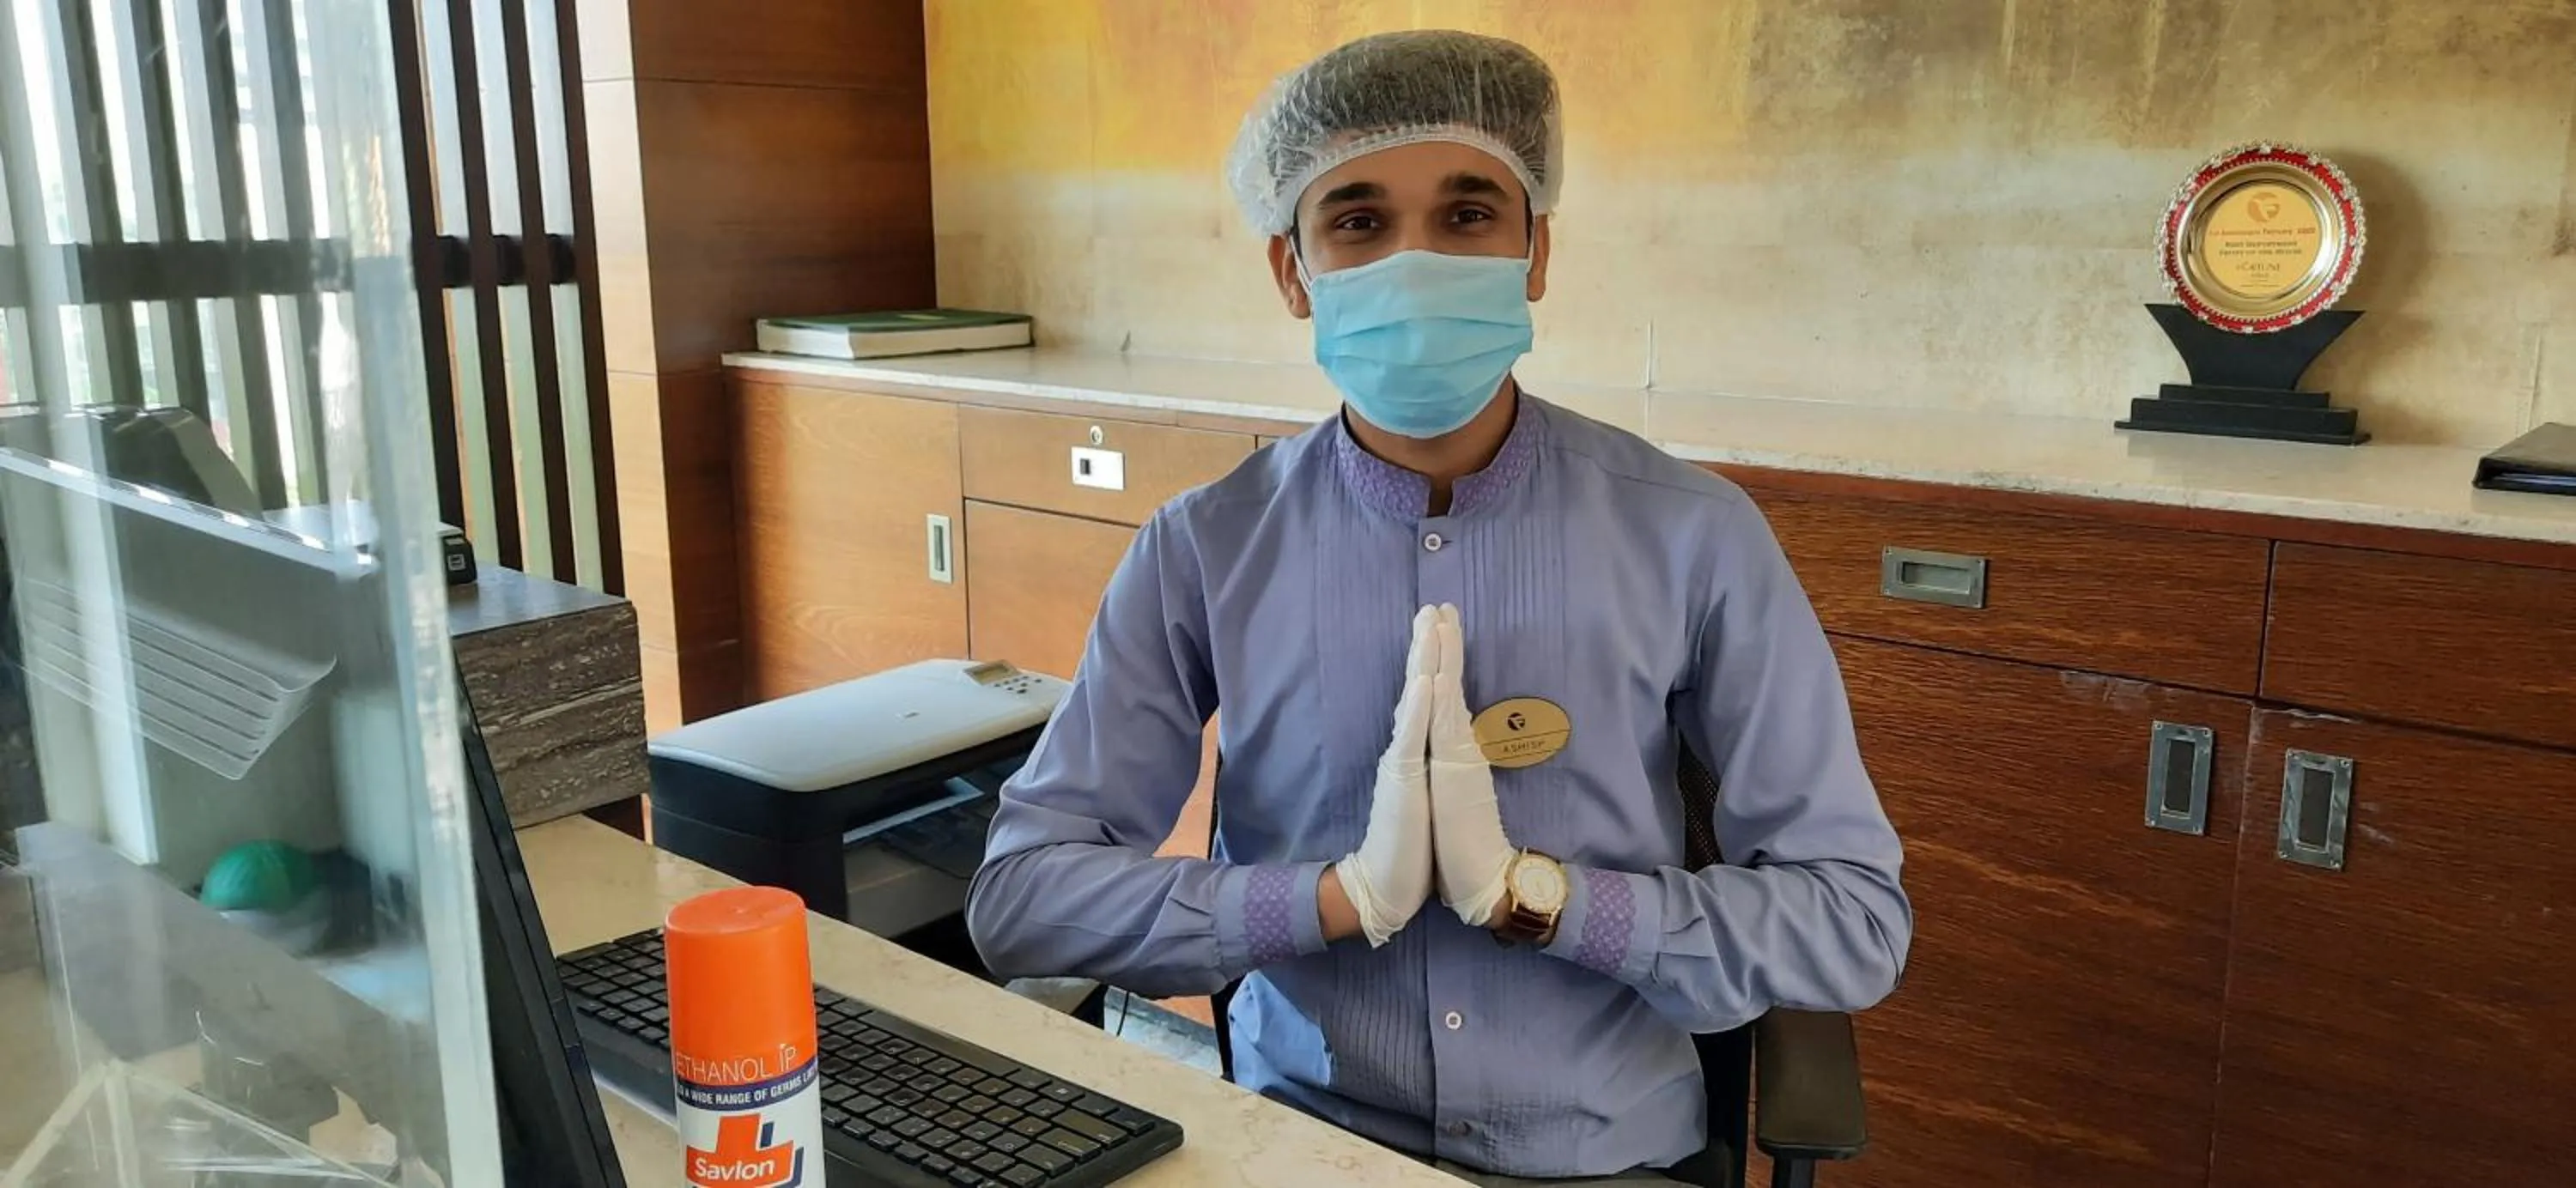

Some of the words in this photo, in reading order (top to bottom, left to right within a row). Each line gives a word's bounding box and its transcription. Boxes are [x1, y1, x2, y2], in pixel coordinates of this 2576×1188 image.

[676, 1052, 774, 1083] ETHANOL
[691, 1089, 714, 1105] WIDE
[715, 1092, 751, 1105] RANGE
[753, 1088, 769, 1101] OF
[770, 1076, 803, 1098] GERMS
[695, 1157, 776, 1182] Savlon
